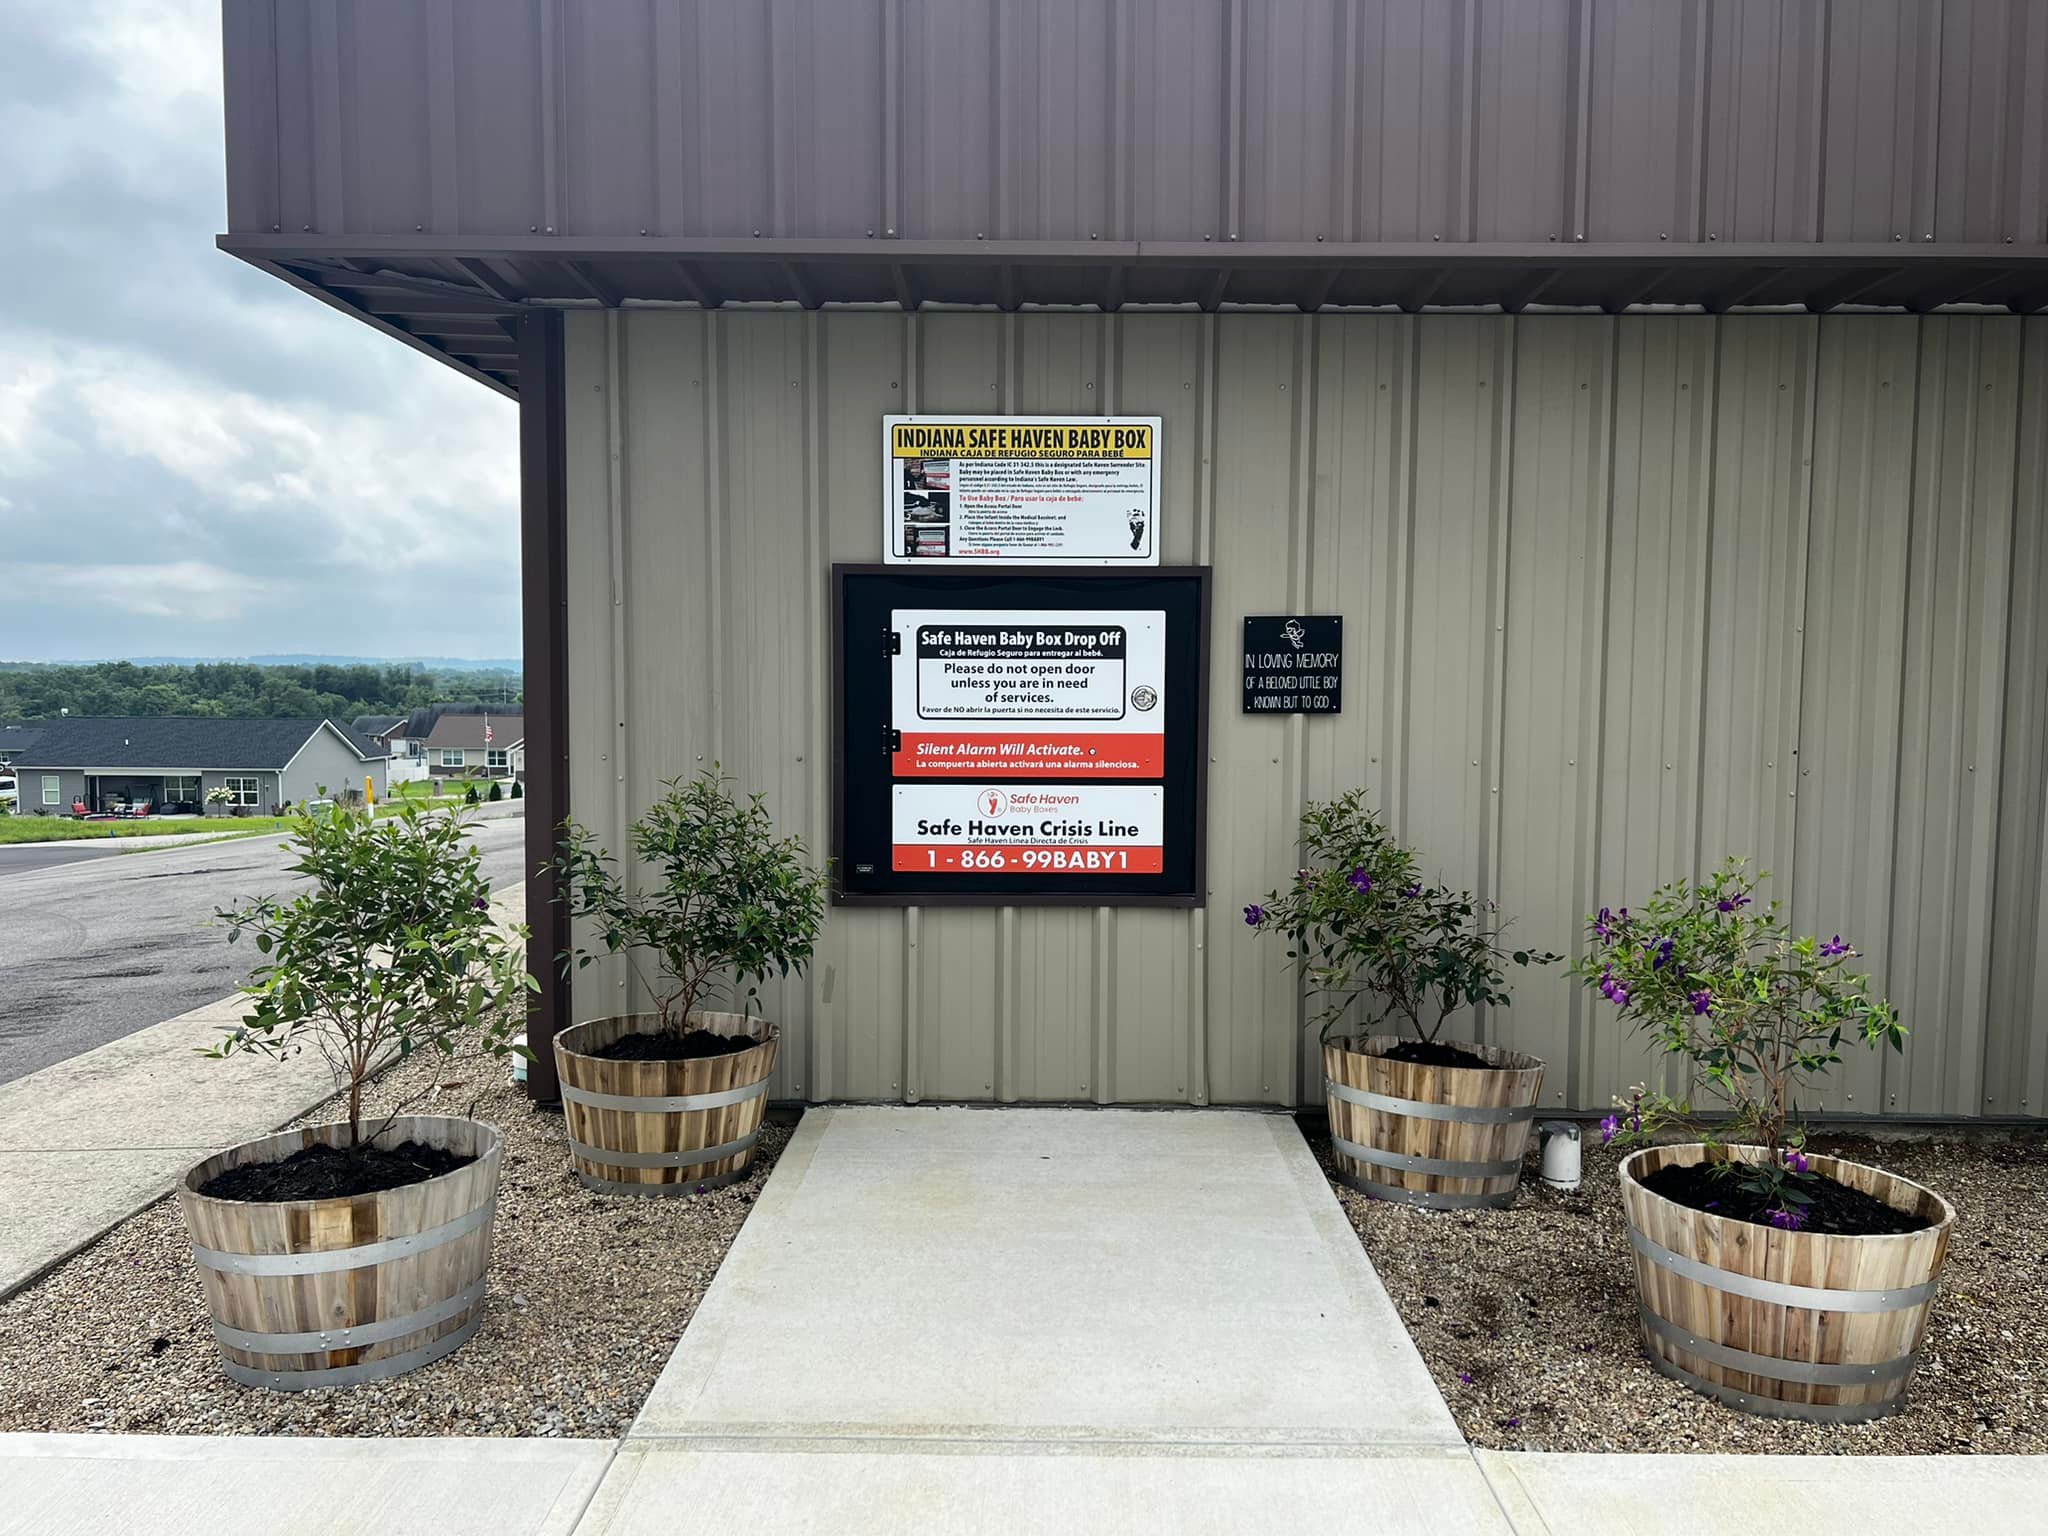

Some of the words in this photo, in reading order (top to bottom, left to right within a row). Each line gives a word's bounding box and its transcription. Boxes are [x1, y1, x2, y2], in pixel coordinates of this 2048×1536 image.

[897, 429, 965, 448] INDIANA
[969, 429, 1007, 448] SAFE
[1011, 429, 1063, 448] HAVEN
[1069, 430, 1110, 448] BABY
[1115, 430, 1146, 448] BOX
[1102, 449, 1124, 457] BEBÉ
[922, 631, 952, 645] Safe
[955, 632, 996, 645] Haven
[1000, 632, 1033, 649] Baby
[1036, 632, 1061, 645] Box
[1065, 632, 1096, 649] Drop
[1100, 632, 1120, 645] Off
[1245, 654, 1255, 668] IN
[1259, 654, 1292, 668] LOVING
[1296, 653, 1338, 668] MEMORY
[944, 663, 984, 673] Please
[987, 663, 1003, 673] do
[1007, 665, 1027, 674] not
[1031, 666, 1062, 676] open
[1066, 664, 1095, 674] door
[951, 677, 990, 688] unless
[994, 680, 1016, 690] you
[1020, 680, 1039, 688] are
[1043, 678, 1054, 688] in
[1058, 678, 1088, 688] need
[1246, 676, 1256, 689] OF
[1258, 677, 1264, 688] A
[1266, 676, 1297, 689] BELOVED
[1300, 676, 1320, 689] LITTLE
[1323, 676, 1338, 688] BOY
[985, 692, 998, 702] of
[1001, 692, 1054, 702] services.
[1254, 696, 1280, 708] KNOWN
[1283, 696, 1298, 708] BUT
[1302, 696, 1311, 708] TO
[1314, 696, 1329, 708] GOD
[917, 743, 954, 755] Silent
[956, 743, 996, 755] Alarm
[1000, 743, 1025, 755] Will
[1026, 744, 1084, 755] Activate.
[916, 760, 926, 768] La
[928, 761, 975, 769] compuerta
[976, 760, 1007, 768] abierta
[1009, 760, 1043, 768] activará
[1064, 760, 1093, 768] alarma
[1095, 760, 1140, 768] silenciosa.
[1010, 793, 1037, 804] Safe
[1040, 794, 1079, 804] Haven
[1010, 805, 1031, 813] Baby
[917, 819, 962, 835] Safe
[969, 820, 1033, 836] Haven
[1040, 820, 1092, 836] Crisis
[1099, 820, 1139, 836] Line
[928, 850, 935, 868] 1
[961, 850, 1005, 868] 866
[1022, 851, 1127, 869] 99BABY1
